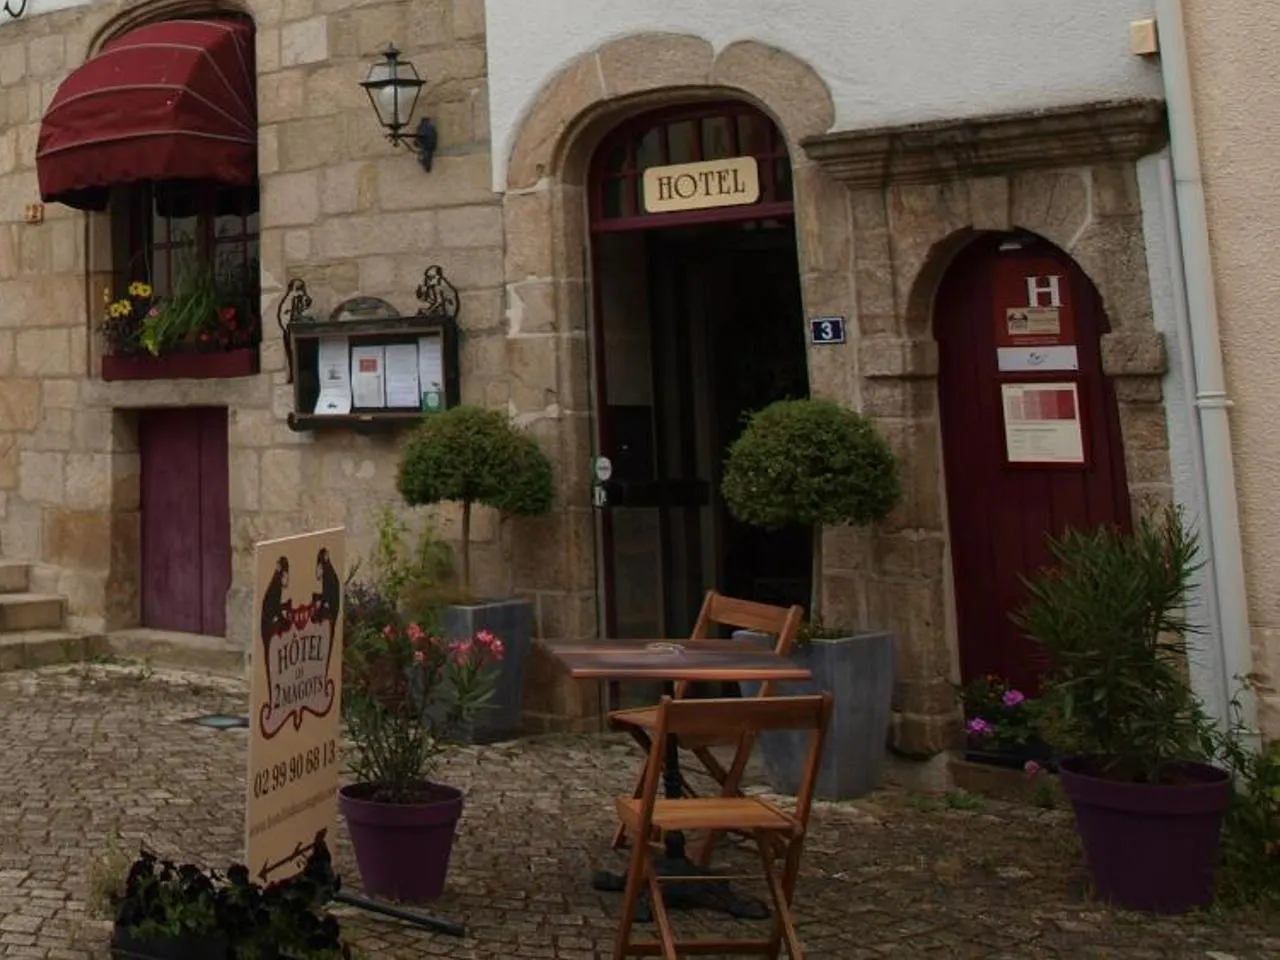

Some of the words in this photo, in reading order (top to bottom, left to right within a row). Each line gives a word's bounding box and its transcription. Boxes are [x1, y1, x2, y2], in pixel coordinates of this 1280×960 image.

[656, 168, 746, 201] HOTEL
[1024, 275, 1065, 308] H
[821, 321, 833, 340] 3
[277, 633, 324, 675] HÔTEL
[253, 768, 270, 799] 02
[272, 761, 288, 791] 99
[289, 752, 304, 783] 90
[305, 746, 321, 775] 68
[322, 739, 336, 768] 13
